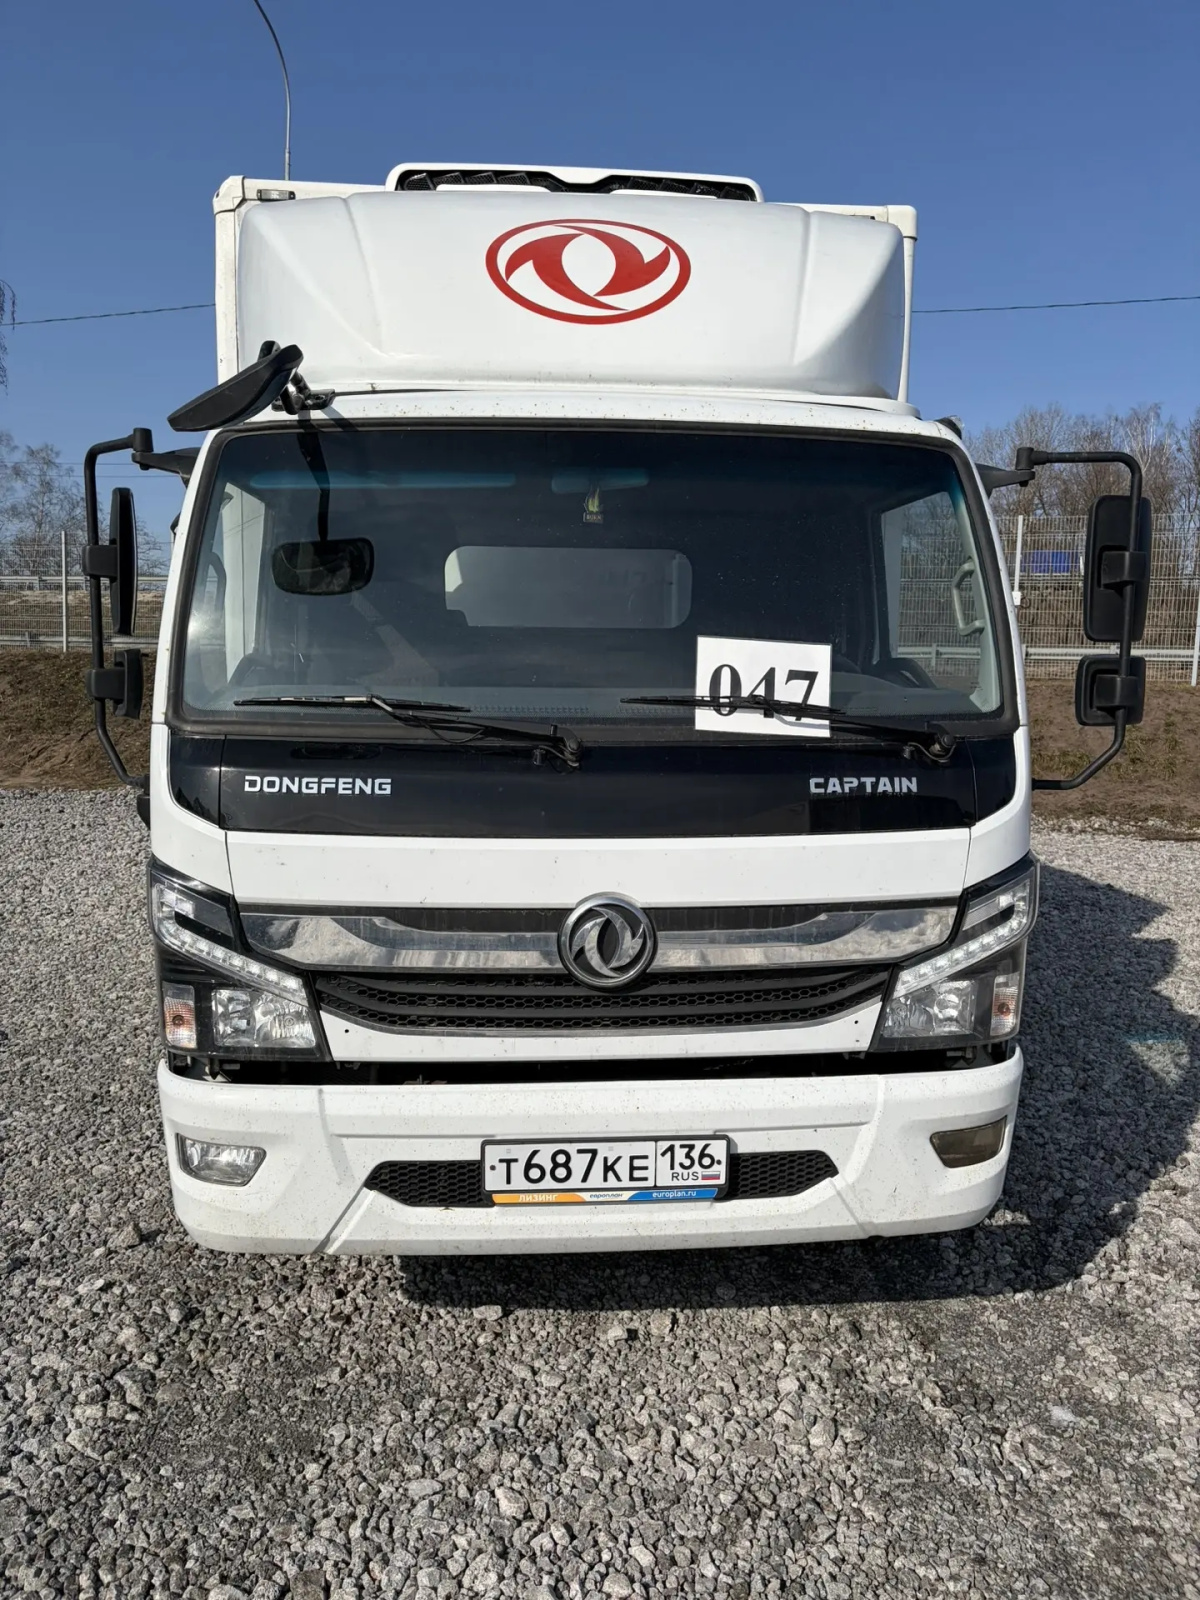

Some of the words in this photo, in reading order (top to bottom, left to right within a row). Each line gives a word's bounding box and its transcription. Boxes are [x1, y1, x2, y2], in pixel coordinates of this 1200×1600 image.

[709, 663, 819, 721] 047
[244, 775, 392, 795] DONGFENG
[809, 776, 918, 794] CAPTAIN
[660, 1143, 716, 1171] 136
[671, 1171, 699, 1182] RUS
[518, 1193, 558, 1203] ЛИЗИНГ
[652, 1189, 697, 1199] europlan.ru
